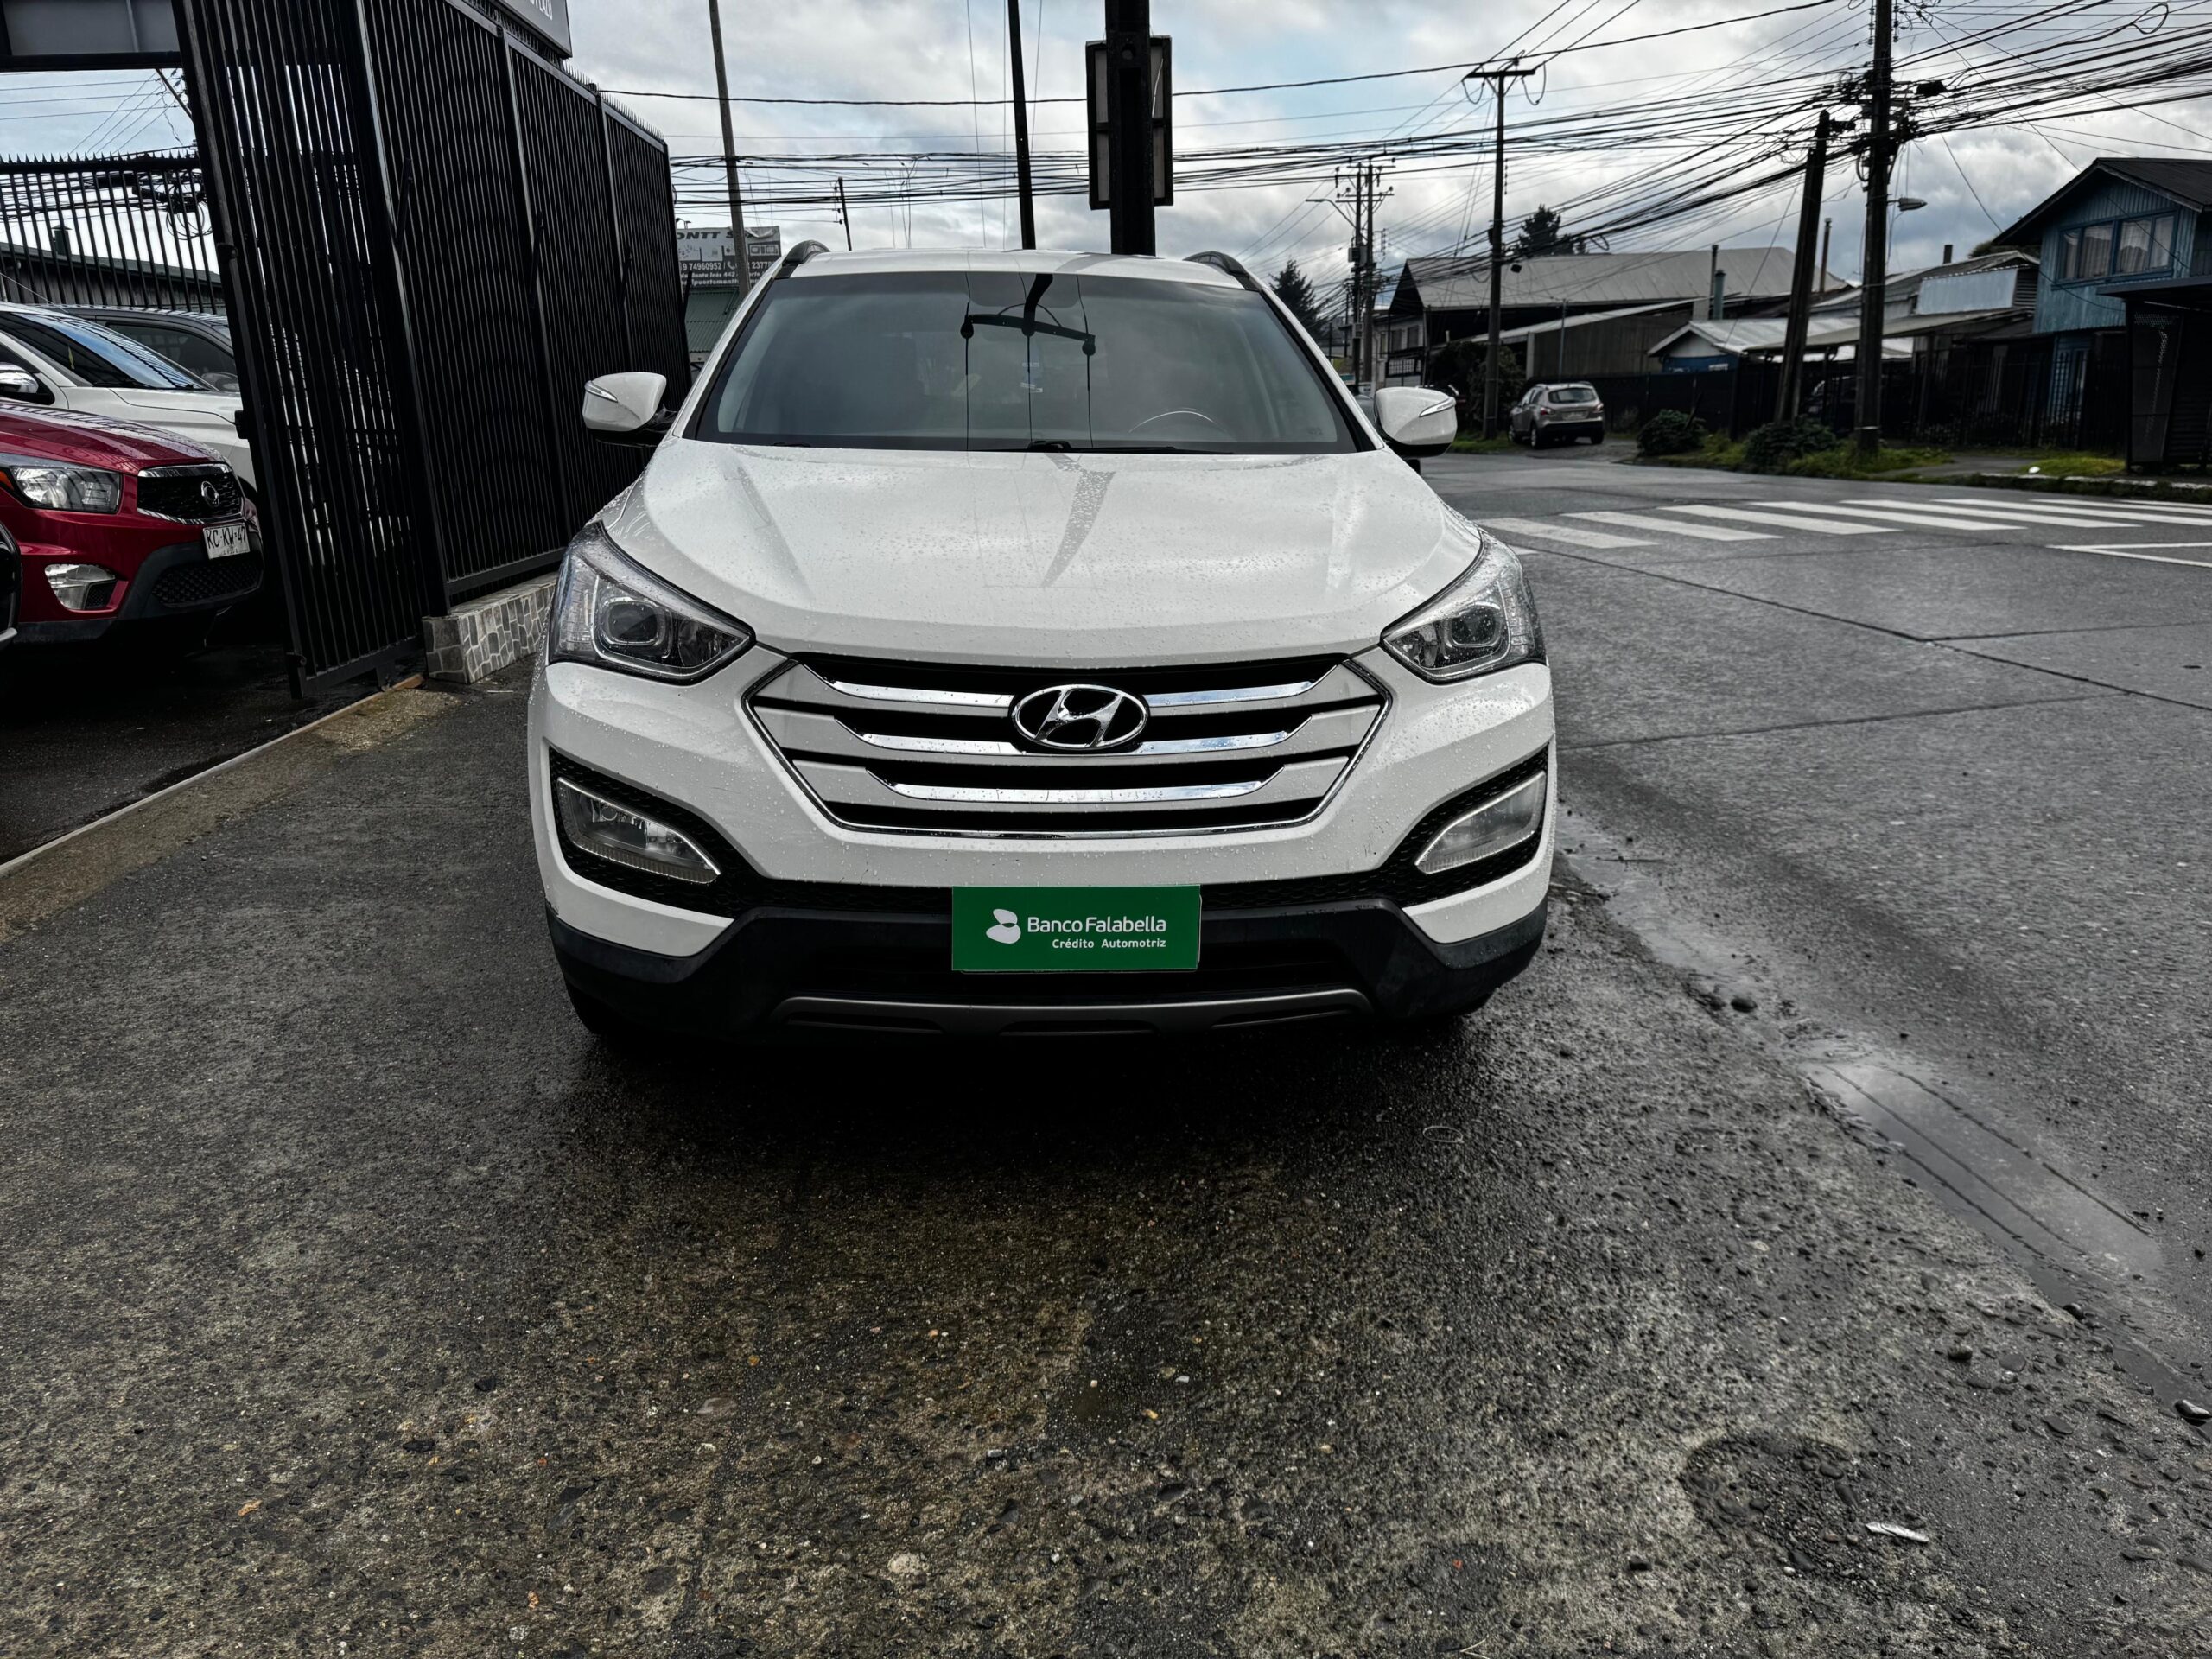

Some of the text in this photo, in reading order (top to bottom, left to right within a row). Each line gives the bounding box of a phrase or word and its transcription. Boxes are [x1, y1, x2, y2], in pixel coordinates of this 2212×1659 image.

[1027, 916, 1166, 933] Banco Falabella
[1052, 938, 1166, 949] Crédito Automotriz
